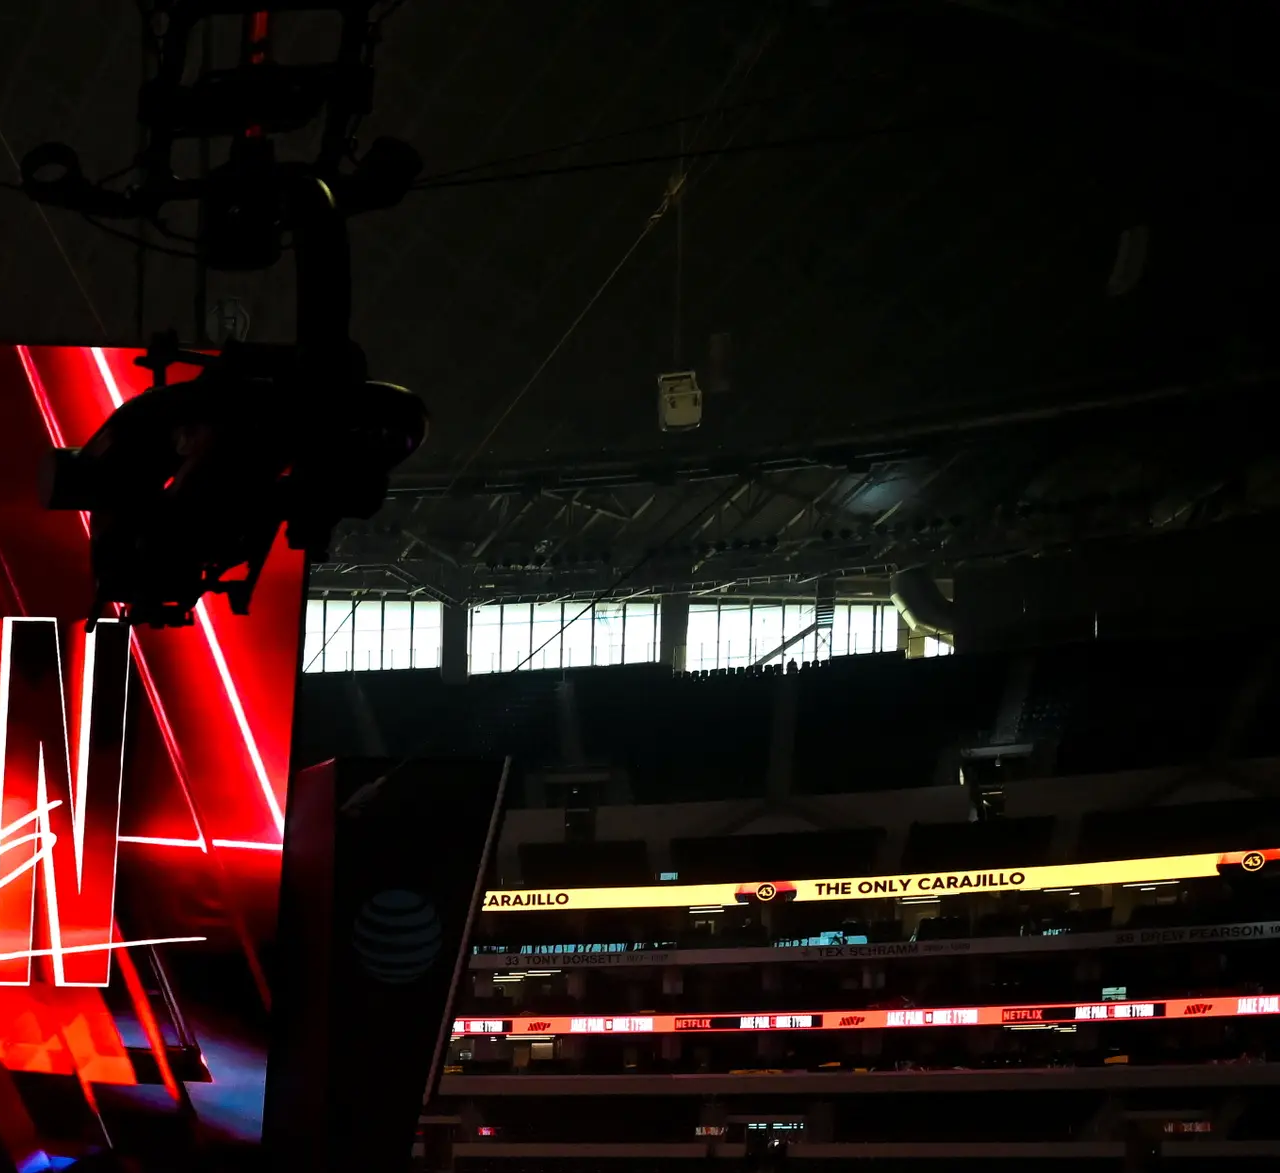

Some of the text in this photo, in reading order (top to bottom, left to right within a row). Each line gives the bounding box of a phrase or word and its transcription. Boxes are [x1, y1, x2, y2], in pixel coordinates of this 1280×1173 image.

[1244, 855, 1262, 868] 43
[816, 872, 1024, 895] THE ONLY CARAJILLO
[760, 886, 773, 897] 43
[1141, 931, 1183, 942] DREW
[1190, 926, 1264, 939] PEARSON
[818, 946, 844, 956] TEX
[849, 944, 918, 956] SCHRAMM
[505, 954, 622, 965] 33 TONY DORSETT
[1075, 1006, 1107, 1019] JAKE PAUL
[1237, 998, 1257, 1014] JAKE
[887, 1011, 923, 1025] JAKE PAUL
[1003, 1010, 1041, 1020] NETFLIX
[588, 1018, 604, 1031] PAUL
[676, 1020, 710, 1028] NETFLIX
[740, 1017, 769, 1028] JAKE PAUL
